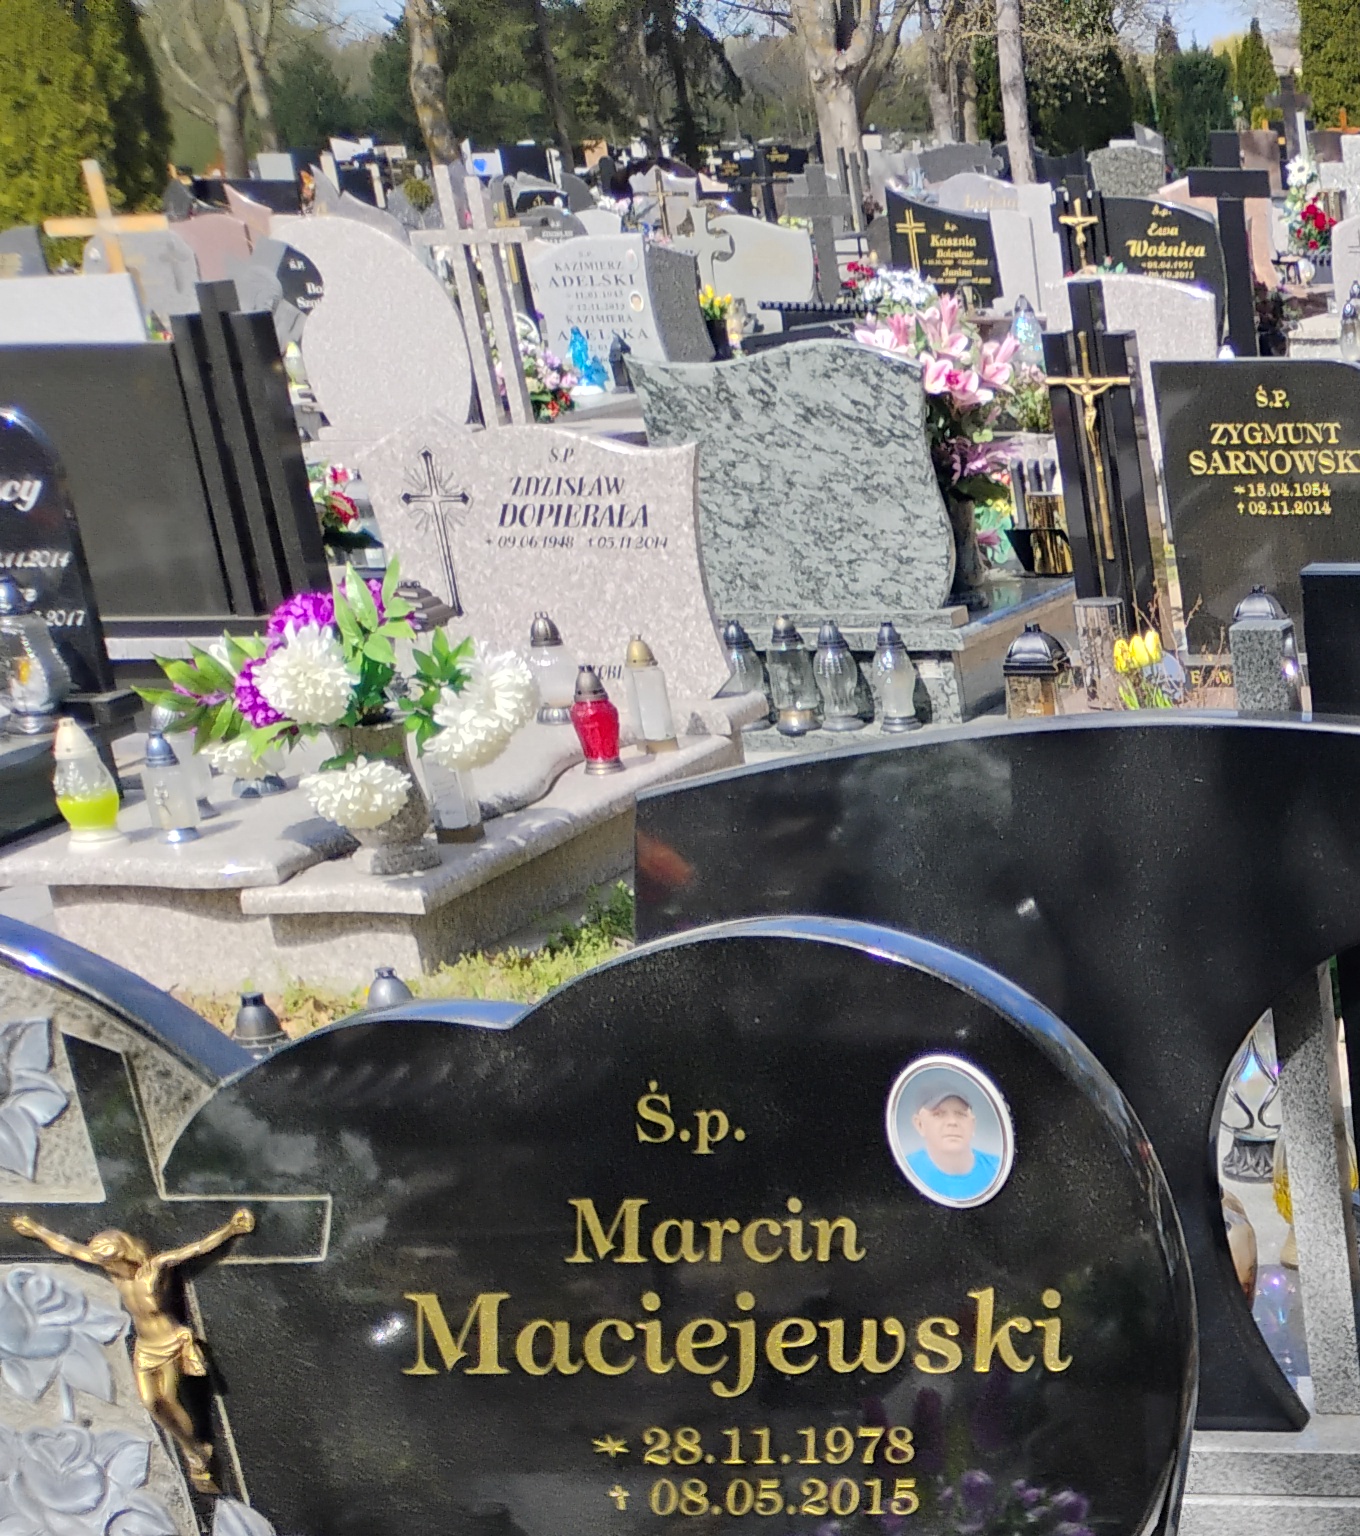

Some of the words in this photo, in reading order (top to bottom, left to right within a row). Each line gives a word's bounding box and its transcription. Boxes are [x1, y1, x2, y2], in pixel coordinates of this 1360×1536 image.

[549, 274, 635, 288] ADELSKI
[1255, 384, 1291, 408] Ś.P.
[1210, 422, 1342, 446] ZYGMUNT
[510, 476, 625, 496] ZDZISŁAW
[497, 503, 649, 528] DOPIERAŁA
[1247, 501, 1332, 515] 02.11.2014
[636, 1081, 747, 1154] Ś.p.
[564, 1197, 866, 1264] Marcin
[402, 1287, 1072, 1398] Maciejewski
[642, 1427, 915, 1465] 28.11.1978
[651, 1478, 920, 1516] 08.05.2015
